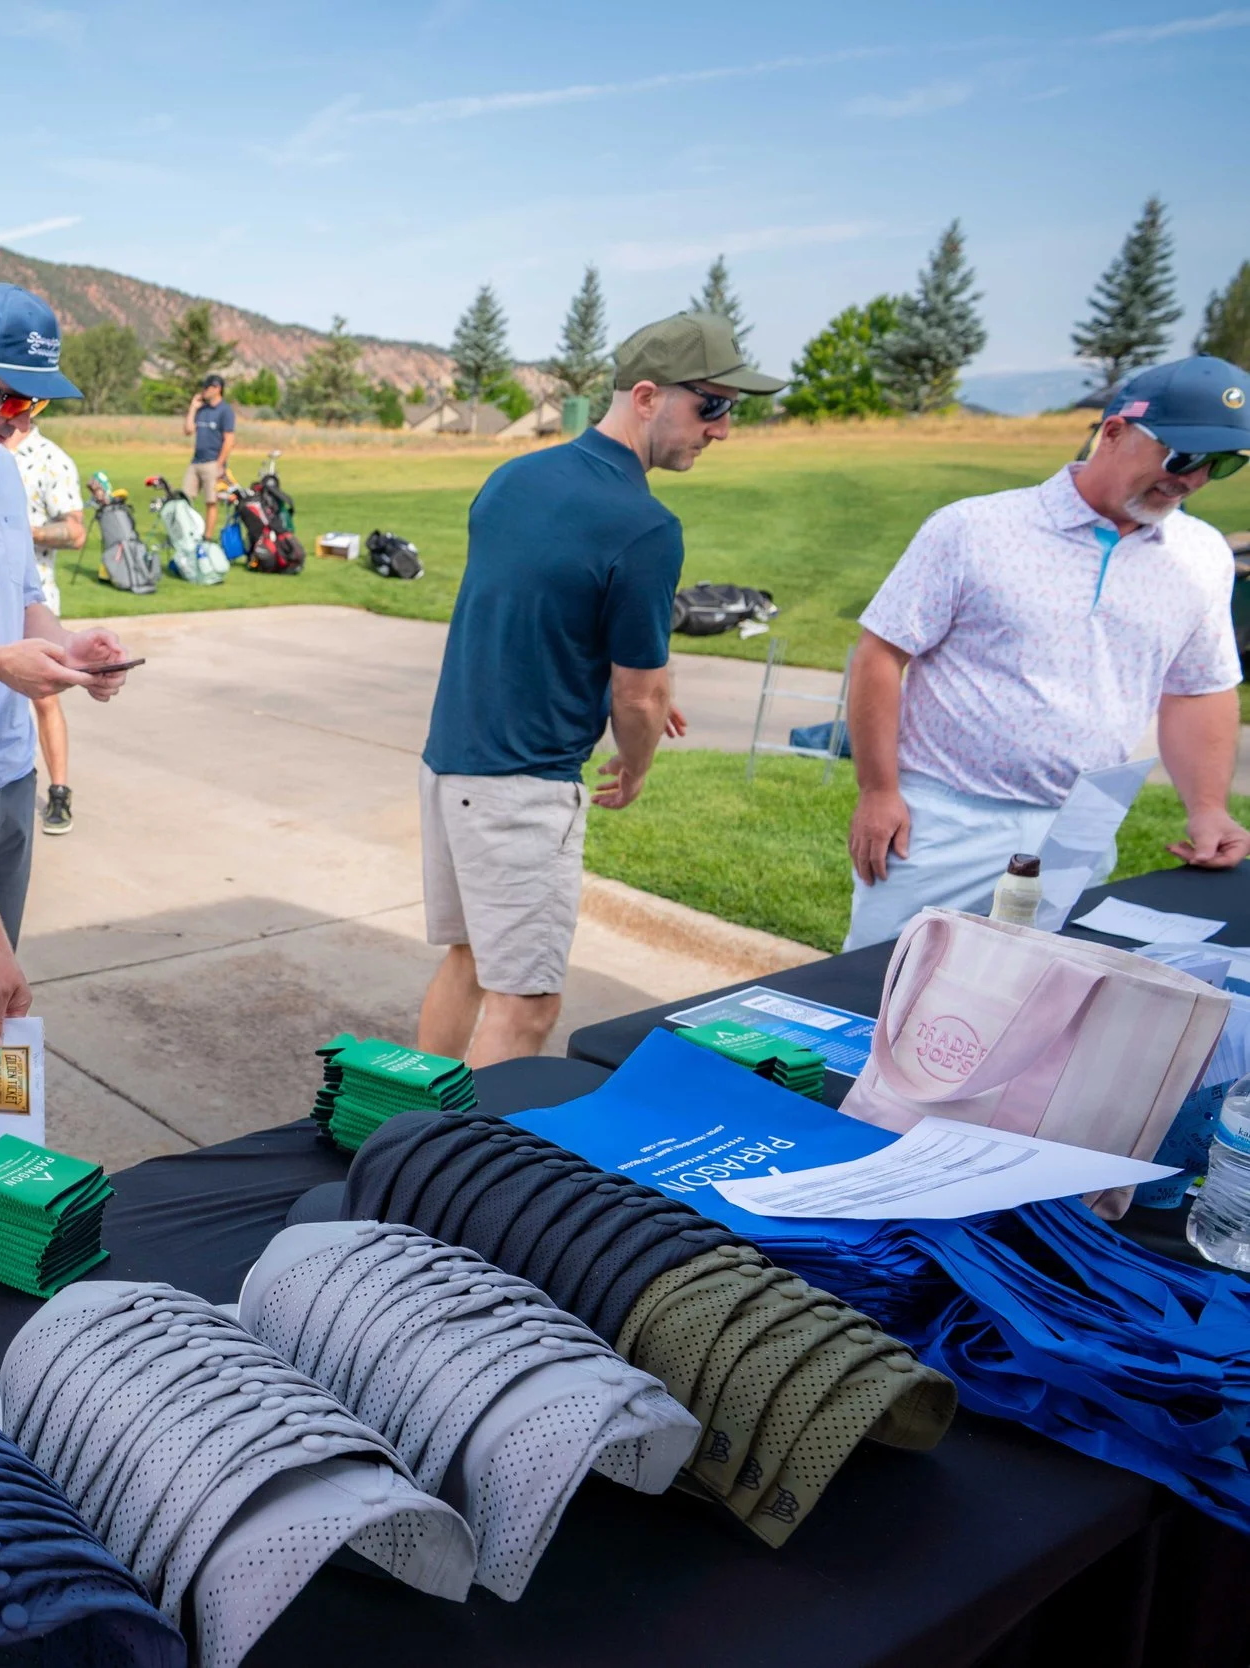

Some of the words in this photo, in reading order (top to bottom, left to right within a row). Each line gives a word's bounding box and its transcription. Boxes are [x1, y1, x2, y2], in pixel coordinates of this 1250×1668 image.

[916, 1043, 975, 1076] JOE'S
[4, 1080, 18, 1105] TICKET
[708, 1136, 745, 1155] SYSTEMS
[3, 1156, 55, 1187] PARAGON
[657, 1135, 796, 1193] PARAGON
